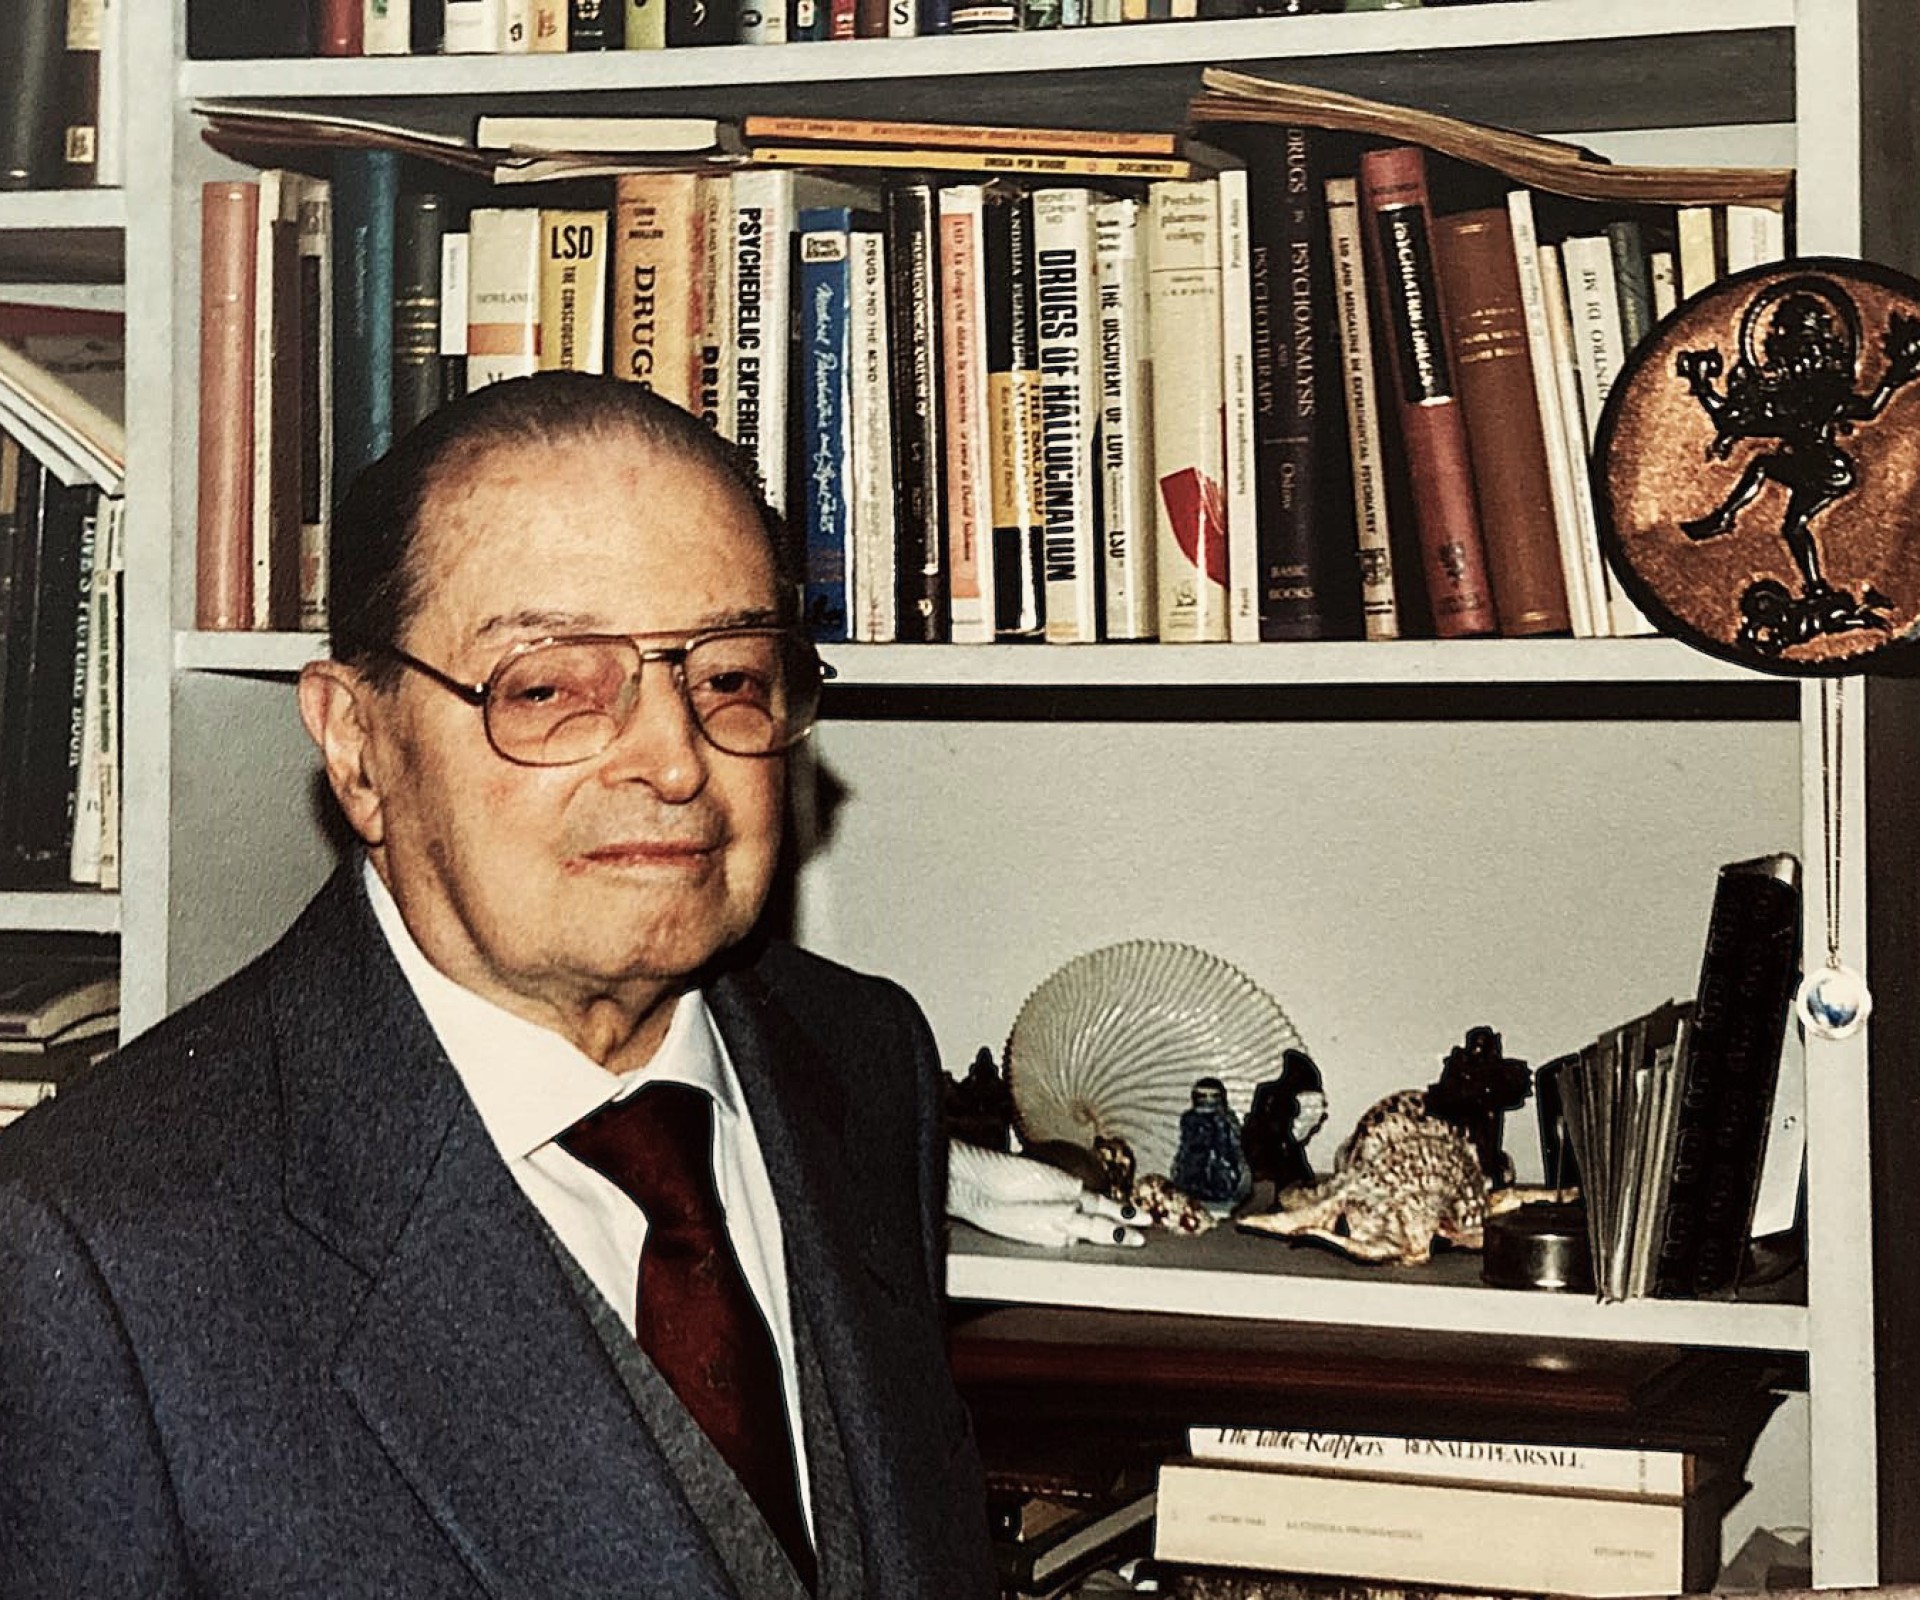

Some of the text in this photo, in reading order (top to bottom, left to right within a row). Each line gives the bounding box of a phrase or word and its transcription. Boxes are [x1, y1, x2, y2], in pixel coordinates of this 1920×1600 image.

[1286, 128, 1308, 193] DRUGS
[552, 226, 593, 259] LSD
[866, 239, 878, 285] DRUGS
[1010, 207, 1023, 275] ANDRIJA
[738, 207, 762, 349] PSYCHEDELIC
[1102, 284, 1122, 310] THE
[1586, 301, 1602, 320] DI
[561, 266, 576, 371] THE CONSCIOUSNES
[1254, 247, 1273, 416] PSYCHOTHERAPY
[1290, 241, 1316, 417] PSYCHOANALYSIS
[1339, 262, 1352, 287] AND
[1360, 465, 1378, 534] PSYCHIATRY
[1590, 329, 1610, 400] DENTRO
[1038, 249, 1081, 582] DRUGS OF HALLUCINATION
